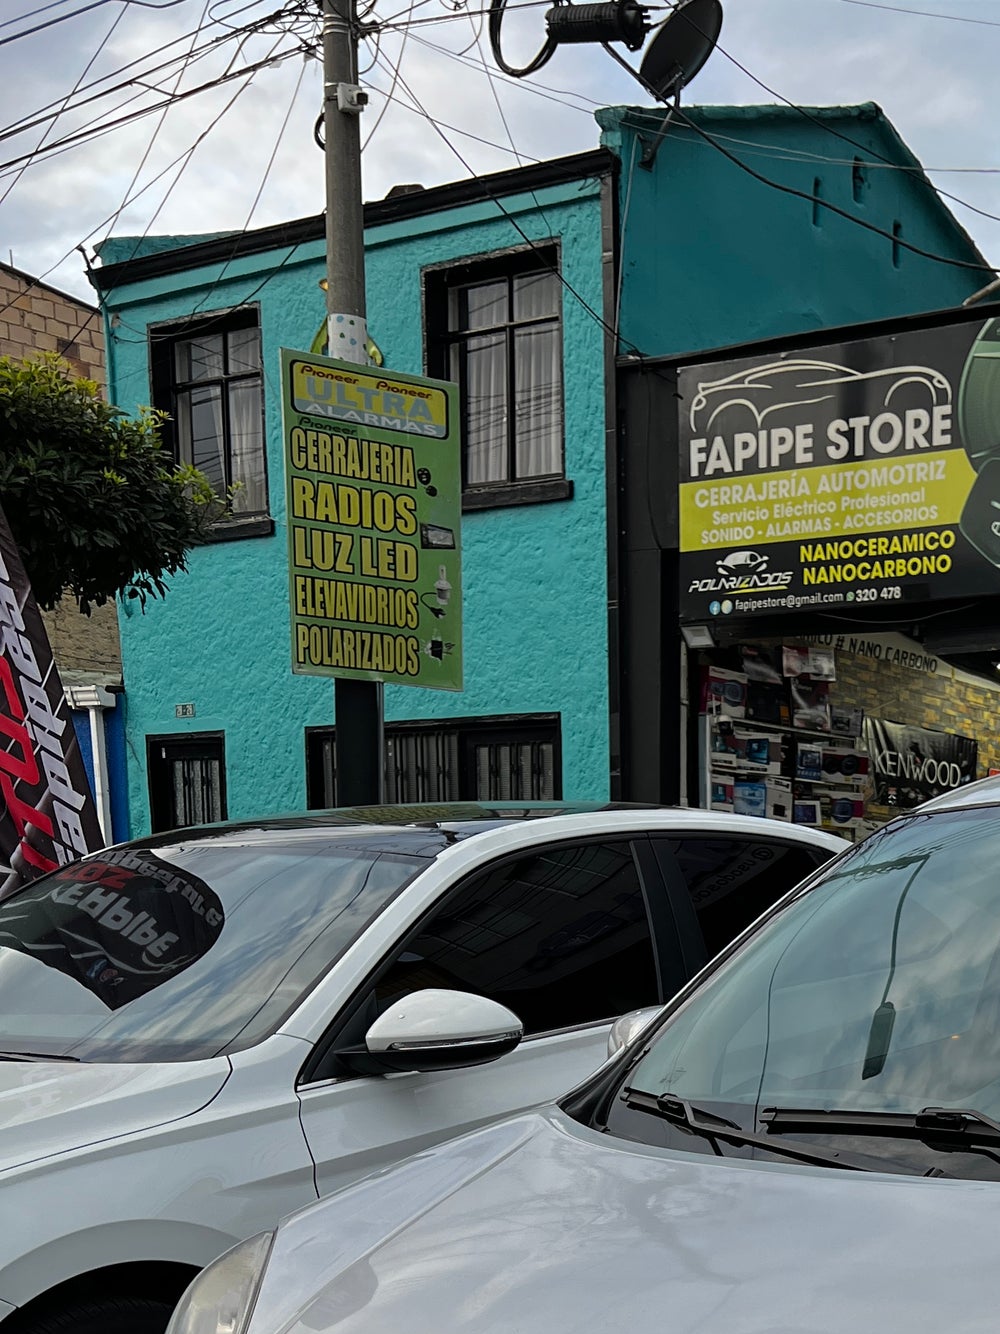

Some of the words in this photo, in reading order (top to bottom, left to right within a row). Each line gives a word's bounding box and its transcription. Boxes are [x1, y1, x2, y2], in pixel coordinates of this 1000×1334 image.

[300, 365, 359, 385] Pioneer
[375, 381, 432, 400] Pioneer
[305, 376, 434, 422] ULTRA
[299, 416, 358, 436] Pioneer
[304, 403, 438, 436] ALARMAS
[290, 426, 417, 489] CERRAJERIA
[689, 423, 814, 477] FAPIPE
[826, 404, 952, 461] STORE
[694, 470, 811, 509] CERRAJERÍA
[816, 459, 947, 495] AUTOMOTRIZ
[291, 475, 417, 536] RADIOS
[701, 526, 755, 544] SONIDO
[765, 519, 832, 538] ALARMAS
[843, 505, 938, 531] ACCESORIOS
[712, 506, 769, 526] Servicio
[773, 499, 836, 520] Eléctrico
[841, 487, 926, 513] Profesional
[292, 525, 355, 575] LUZ
[360, 535, 418, 582] LED
[800, 530, 955, 563] NANOCERAMICO
[688, 571, 793, 593] POLARIZADOS
[803, 554, 952, 586] NANOCARBONO
[294, 574, 419, 630] ELEVAVIDRIOS
[735, 592, 844, 612] fapipestore@gmail.com
[856, 588, 878, 602] 320
[880, 586, 901, 600] 478
[296, 622, 420, 677] POLARIZADOS
[848, 638, 882, 660] NANO
[885, 646, 938, 673] CARBONO
[874, 748, 961, 788] KENWOOD
